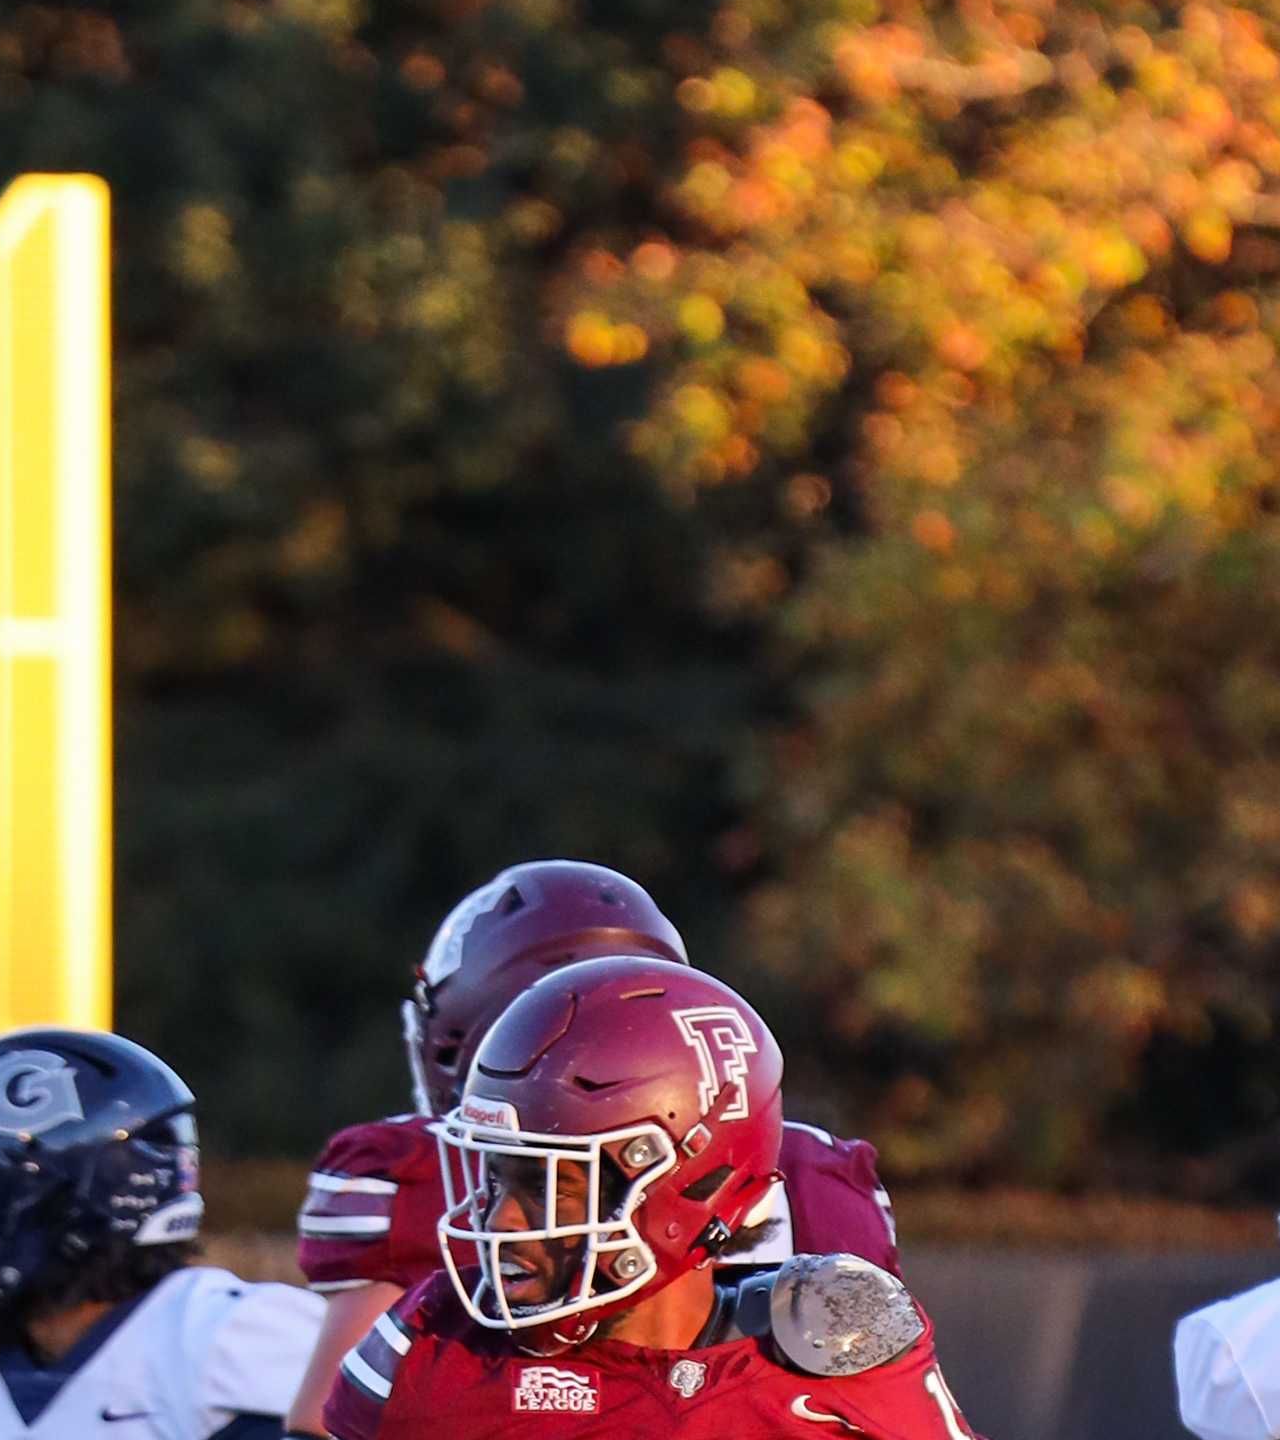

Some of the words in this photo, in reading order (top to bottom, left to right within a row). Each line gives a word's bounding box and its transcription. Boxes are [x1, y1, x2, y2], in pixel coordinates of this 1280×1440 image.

[671, 1006, 758, 1121] F
[514, 1387, 598, 1401] PATRIOT
[514, 1399, 597, 1412] LEAGUE
